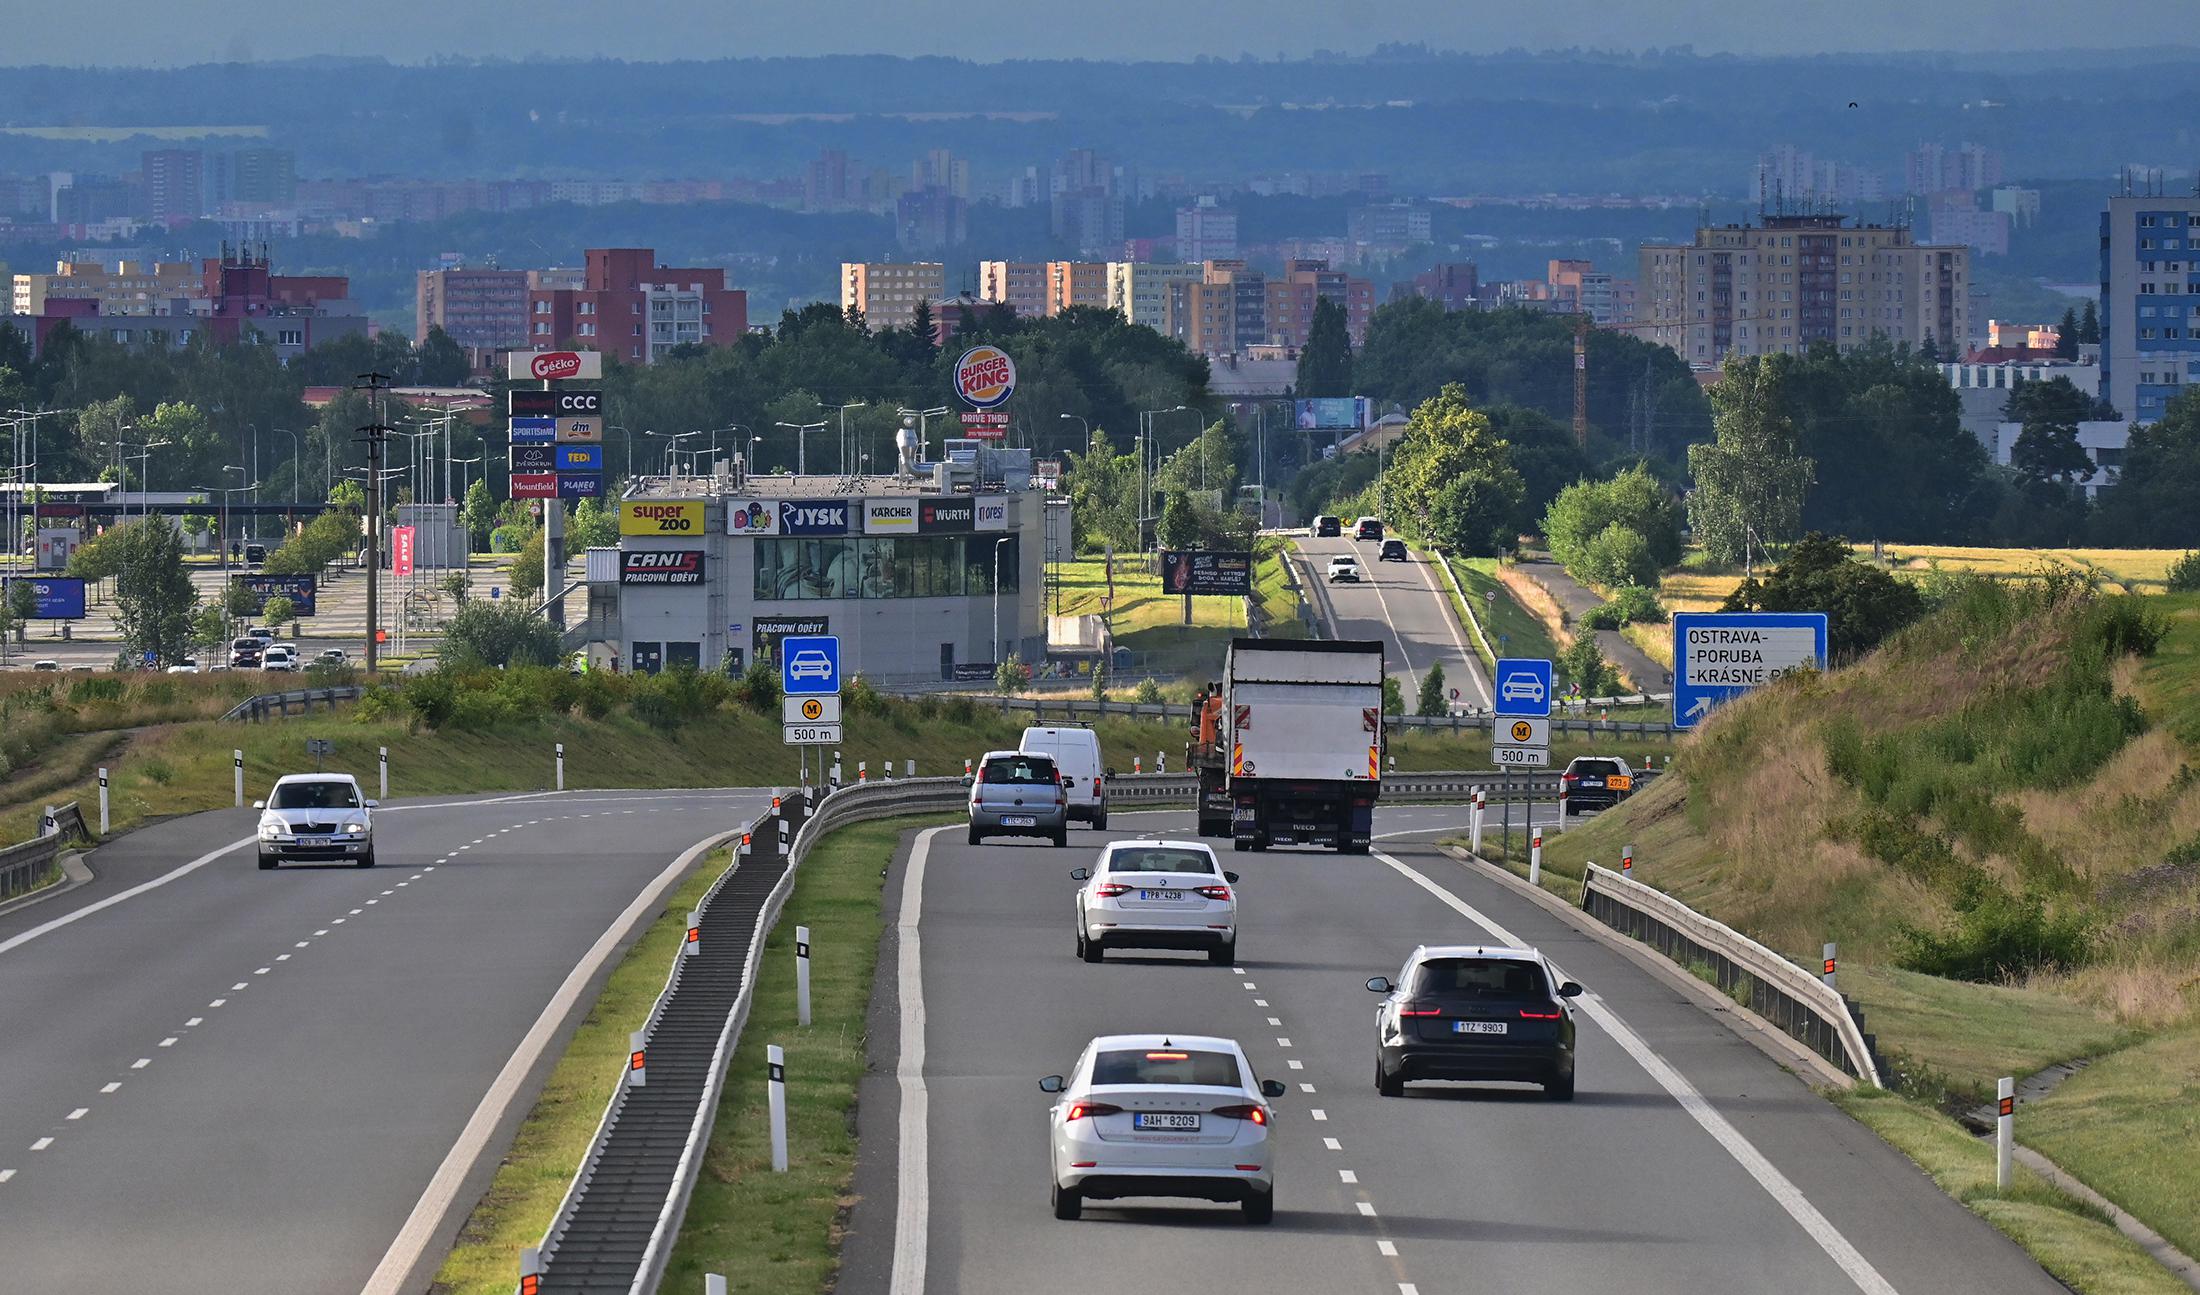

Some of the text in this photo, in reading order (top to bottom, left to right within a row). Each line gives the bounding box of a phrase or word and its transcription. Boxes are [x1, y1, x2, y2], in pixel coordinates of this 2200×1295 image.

[535, 359, 575, 376] Géčko
[960, 357, 1007, 381] BURGER
[963, 367, 1009, 395] KING
[561, 395, 597, 409] CCC
[961, 414, 1009, 423] DRIVE THRU
[513, 427, 554, 436] SPORTISIMO
[571, 421, 590, 432] dm
[513, 482, 554, 491] Mountfield
[563, 481, 595, 489] PLANEO
[633, 505, 685, 524] super
[794, 508, 844, 526] JYSK
[871, 507, 912, 517] KÄRCHER
[935, 508, 970, 521] WÜRTH
[659, 518, 691, 531] zoo
[627, 553, 698, 570] CANIS
[625, 571, 699, 583] PRACOVNÍ ODĚVY
[756, 622, 823, 633] PRACOVNÍ ODĚVY
[1689, 630, 1769, 644] OSTRAVA-
[1689, 650, 1763, 663] -PORUBA
[1689, 666, 1764, 683] -KRÁSNÉ
[807, 705, 817, 714] M
[794, 729, 831, 740] 500 m
[1516, 727, 1527, 736] M
[1502, 750, 1539, 762] 500 m
[1460, 1023, 1504, 1033] 1TZ 9903
[1143, 1115, 1195, 1126] 9AH 8209
